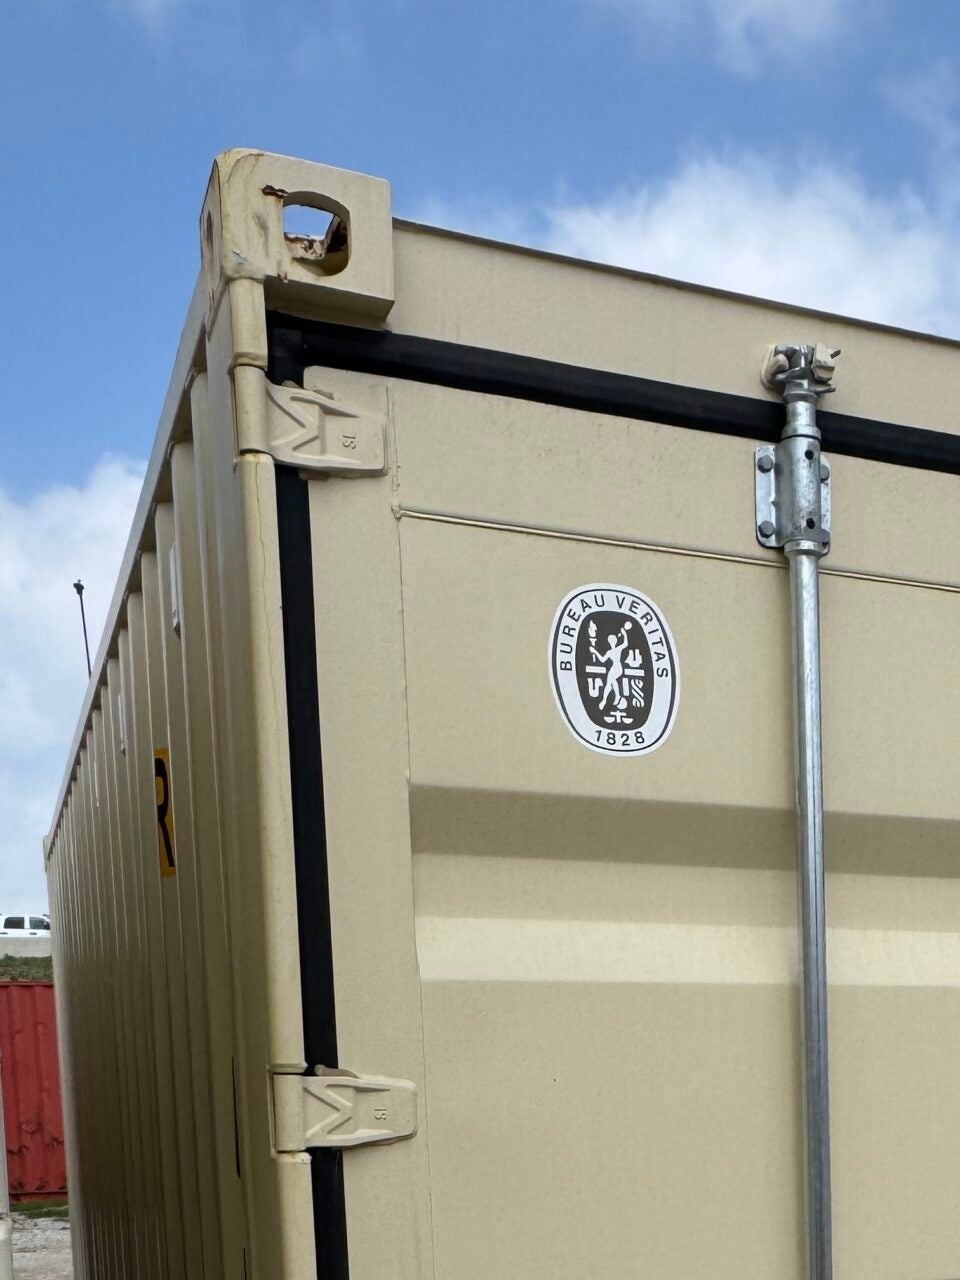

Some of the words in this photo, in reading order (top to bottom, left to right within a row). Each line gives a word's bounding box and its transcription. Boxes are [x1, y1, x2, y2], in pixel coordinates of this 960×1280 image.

[560, 593, 605, 671] BUREAU
[616, 594, 669, 678] VERITAS
[595, 729, 645, 746] 1828
